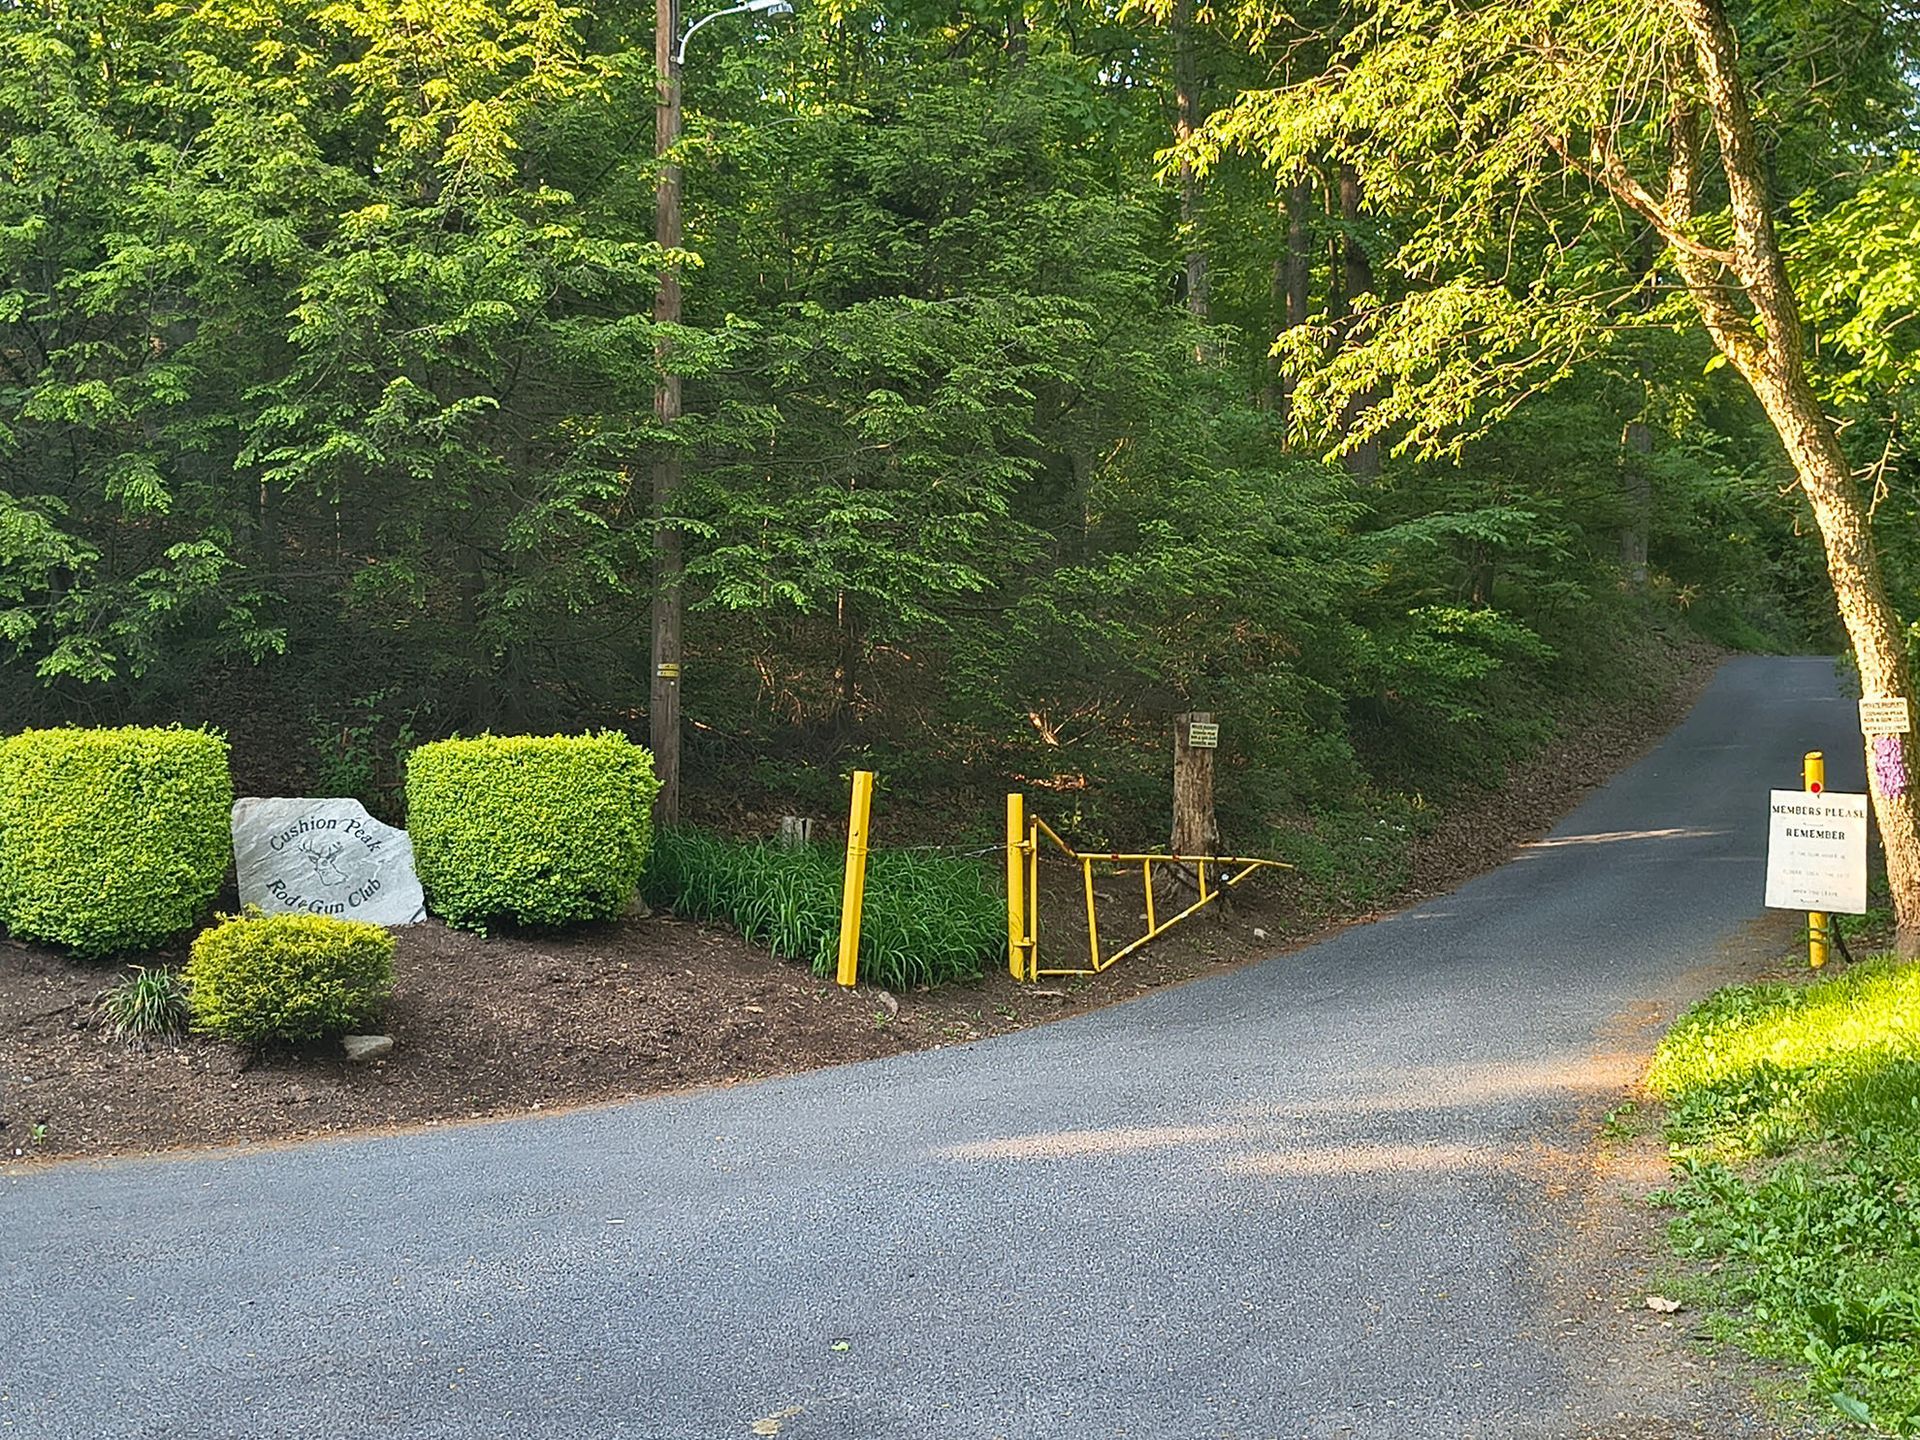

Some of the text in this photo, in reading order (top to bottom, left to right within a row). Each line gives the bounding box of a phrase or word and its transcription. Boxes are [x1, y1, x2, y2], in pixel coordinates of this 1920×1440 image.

[1772, 805, 1865, 819] MEMBERS PLEASE
[270, 816, 383, 852] Cushion Peak
[1786, 828, 1846, 840] REMEMBER
[266, 878, 301, 907] Rod
[308, 900, 345, 915] Gun
[348, 878, 382, 908] Club
